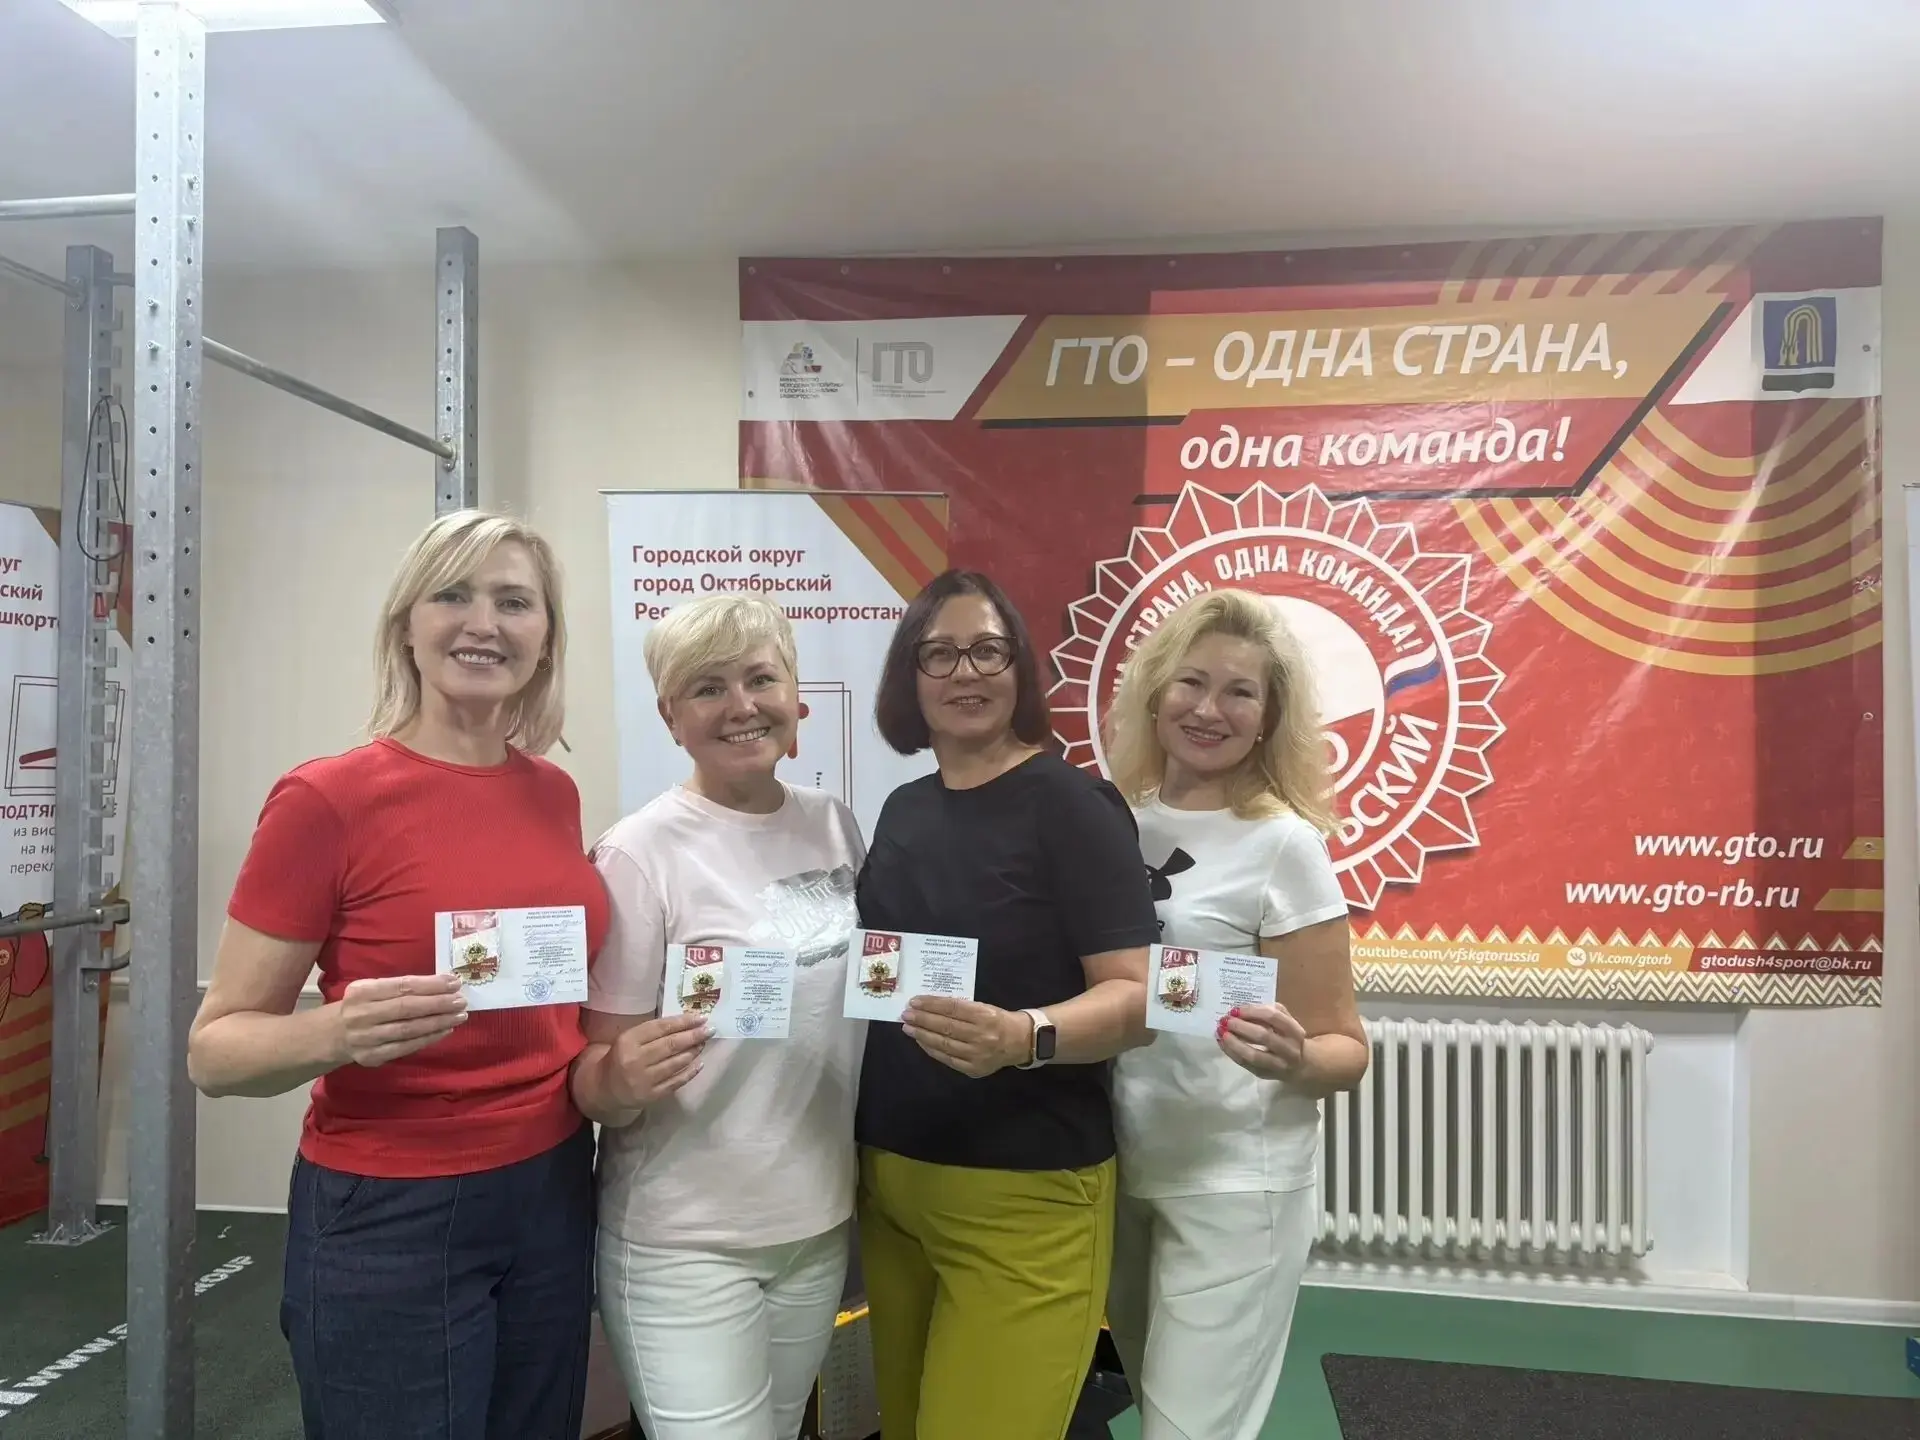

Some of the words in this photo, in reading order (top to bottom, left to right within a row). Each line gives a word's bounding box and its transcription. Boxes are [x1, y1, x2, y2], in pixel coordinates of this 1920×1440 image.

[873, 342, 934, 384] ГТО
[1045, 336, 1149, 387] ГТО
[1213, 326, 1373, 388] ОДНА
[1393, 321, 1630, 381] СТРАНА,
[1179, 424, 1301, 469] одна
[1320, 416, 1571, 465] команда!
[632, 545, 742, 567] Городской
[749, 548, 806, 566] округ
[634, 577, 694, 595] город
[700, 573, 832, 594] Октябрьский
[1214, 544, 1289, 580] ОДНА
[1298, 548, 1426, 654] КОМАНДА!
[0, 611, 59, 631] шкорт
[780, 604, 903, 624] шкортостан
[21, 845, 36, 855] на
[1634, 831, 1823, 864] www.gto.ru
[1565, 879, 1799, 911] www.gto-rb.ru
[1589, 951, 1673, 967] Vk.com/gtorb
[1700, 954, 1872, 972] gtodush4sport@bk.ru
